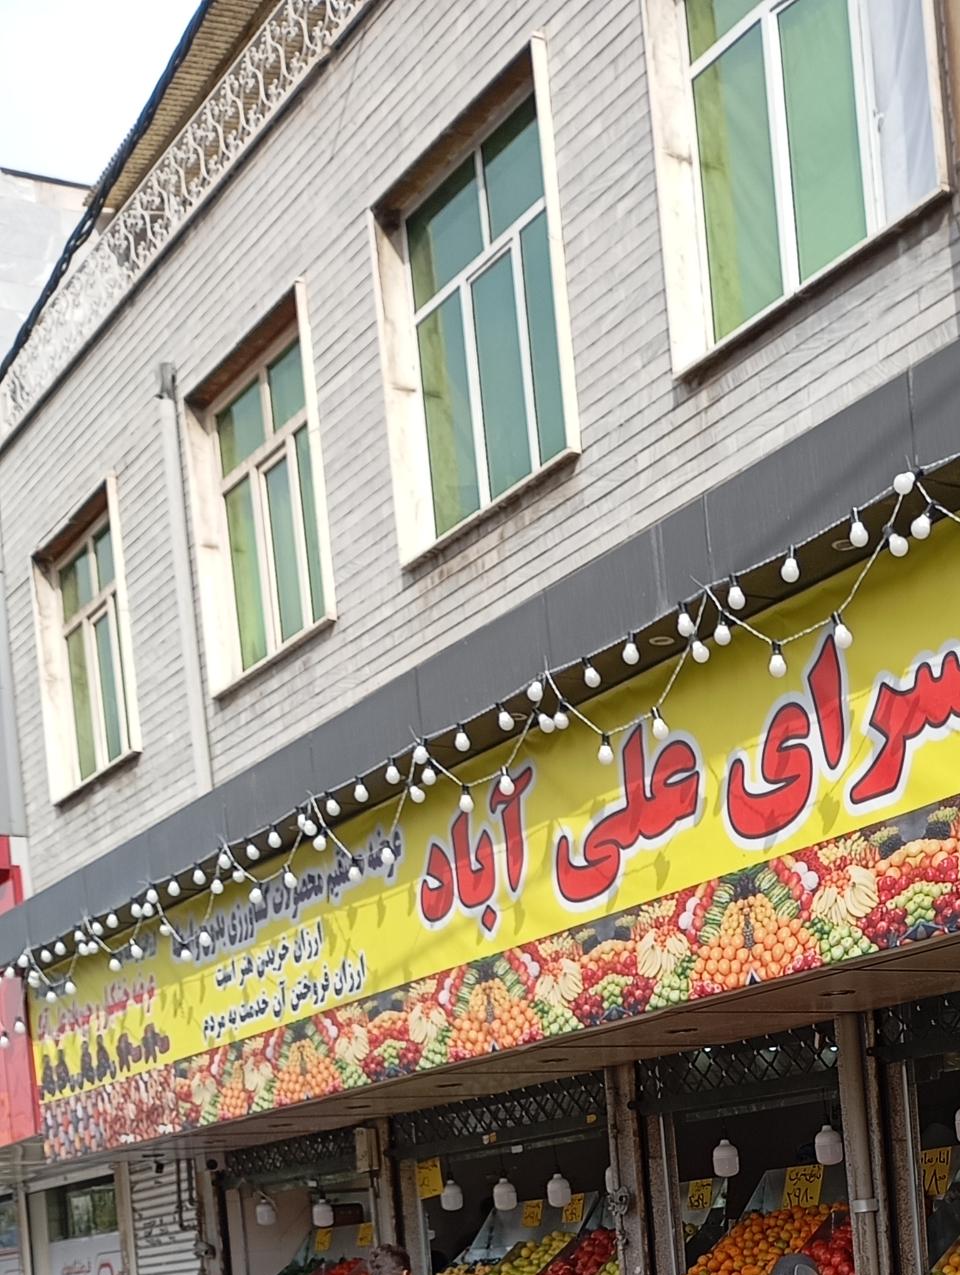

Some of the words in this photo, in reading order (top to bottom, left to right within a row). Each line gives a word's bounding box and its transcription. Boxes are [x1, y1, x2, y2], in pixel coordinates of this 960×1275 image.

[556, 723, 700, 903] علی
[420, 766, 534, 932] آباد
[256, 936, 290, 978] خریدن
[293, 921, 323, 964] ارزان
[215, 959, 236, 987] است
[290, 964, 330, 1012] فروختن
[333, 953, 366, 997] ارزان
[228, 1008, 238, 1031] به
[238, 990, 269, 1023] خدمت
[272, 980, 286, 1019] آن
[202, 1014, 227, 1040] مردم
